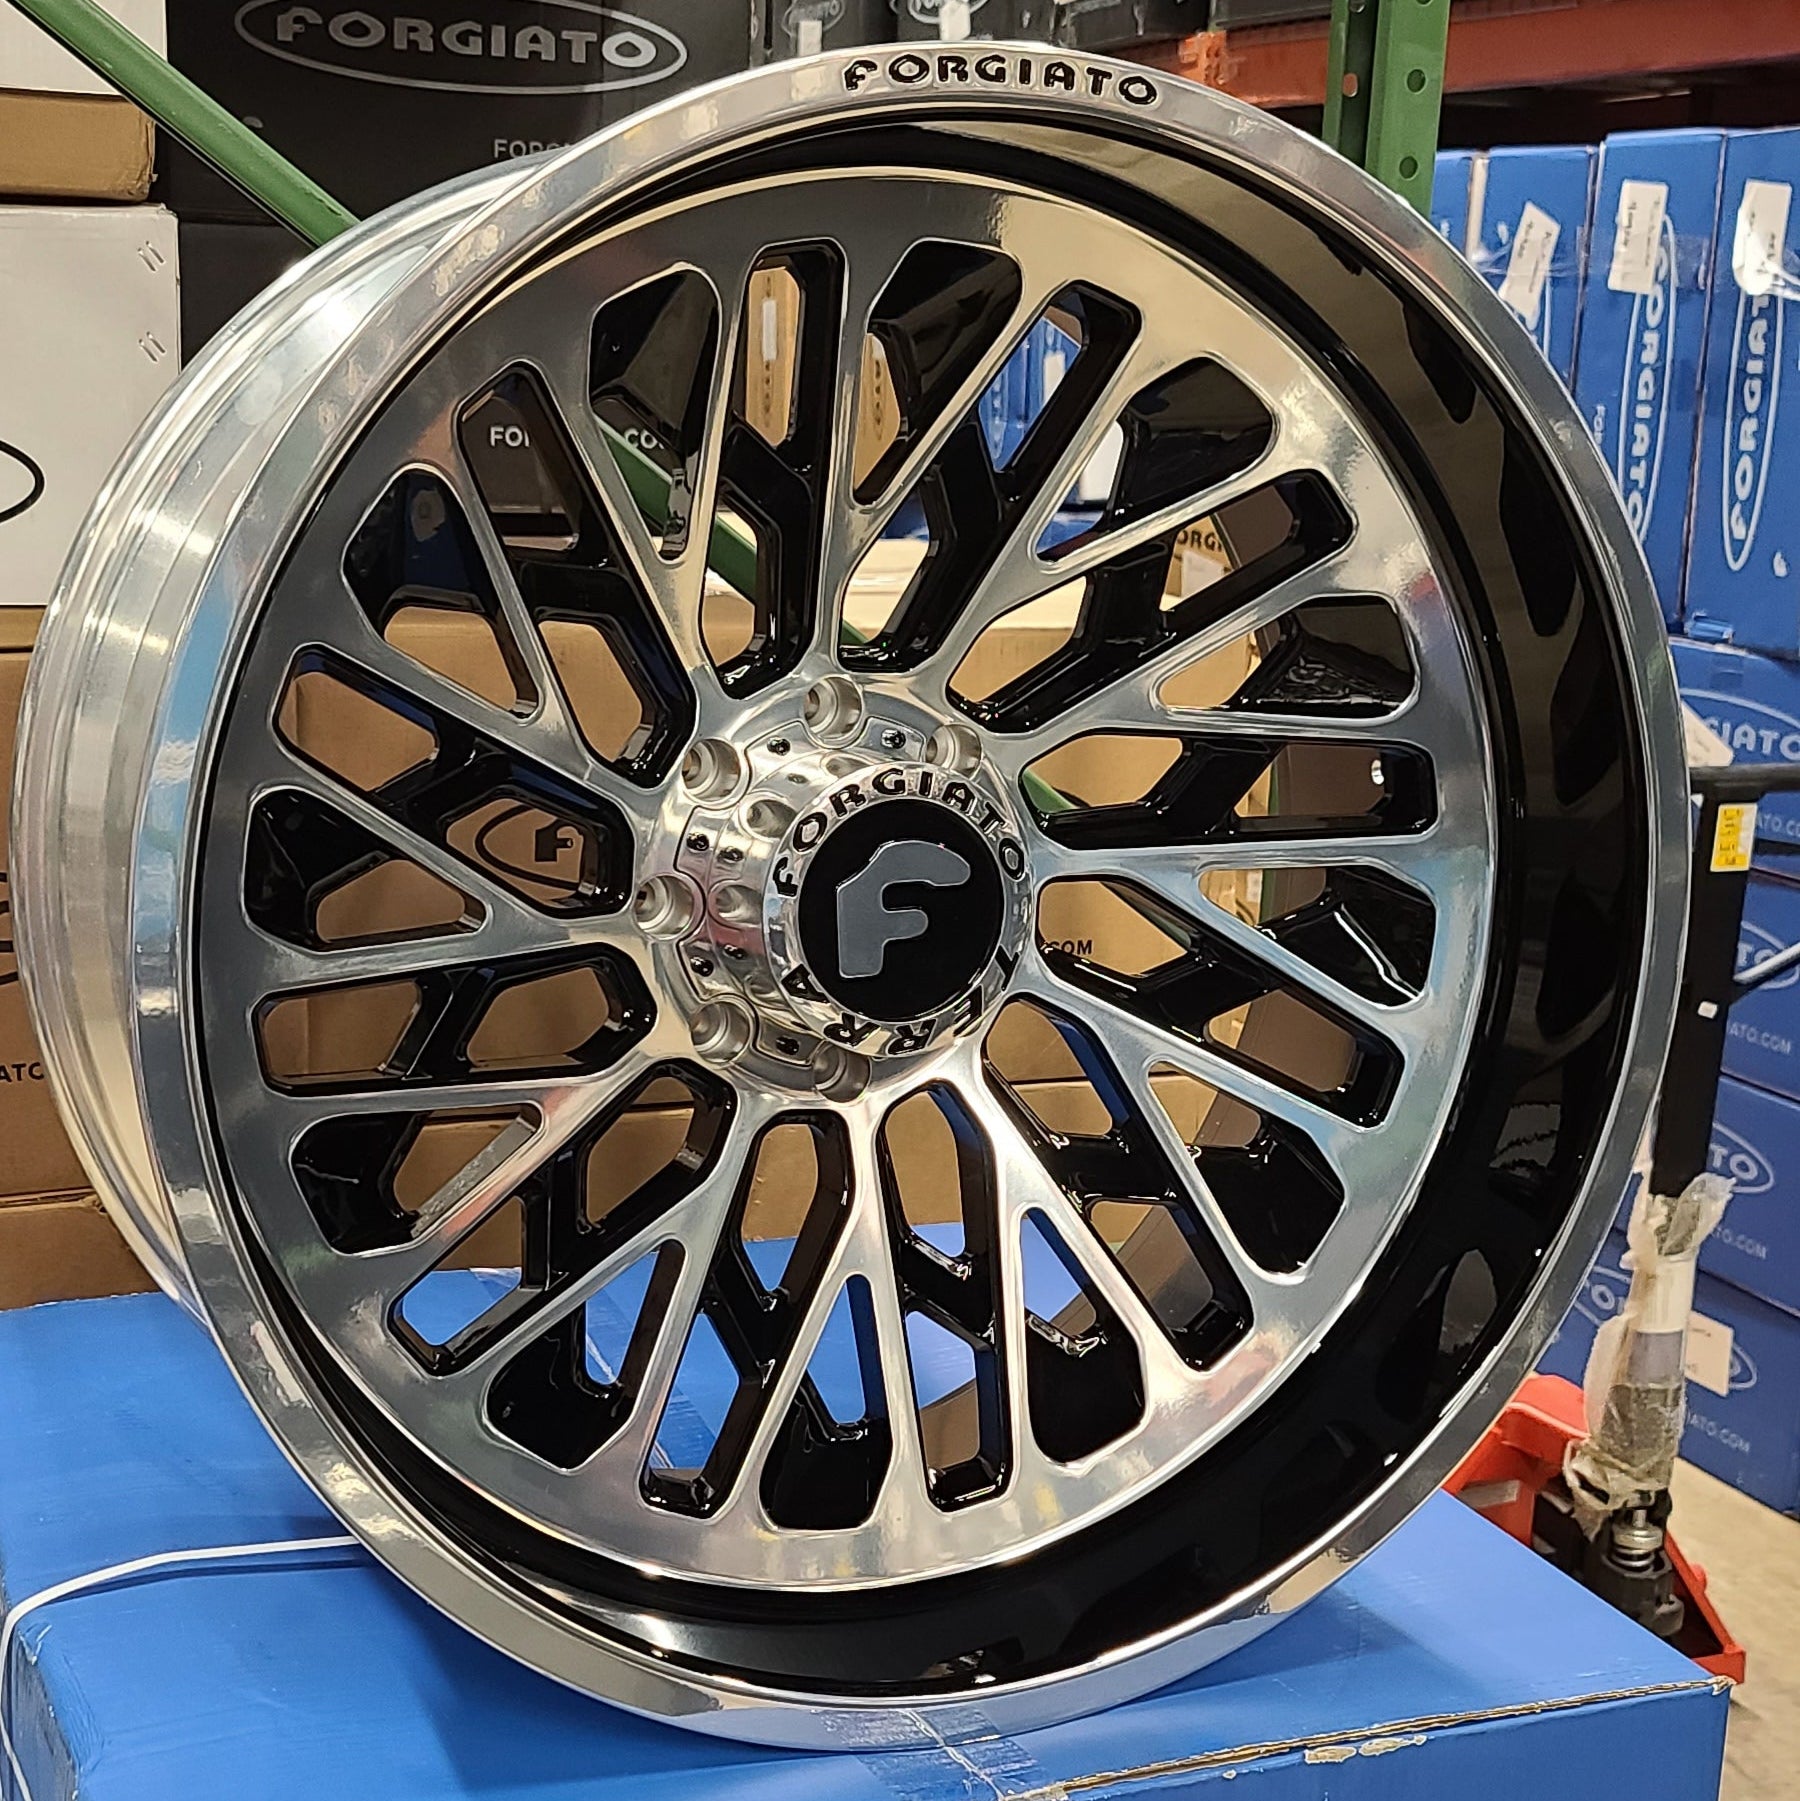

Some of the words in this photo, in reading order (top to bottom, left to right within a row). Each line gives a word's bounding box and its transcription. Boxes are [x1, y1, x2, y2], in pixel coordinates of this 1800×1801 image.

[276, 8, 657, 68] FORGIATO
[843, 54, 1157, 105] FORGIATO
[772, 767, 1025, 898] FORGIATO
[834, 839, 971, 978] F
